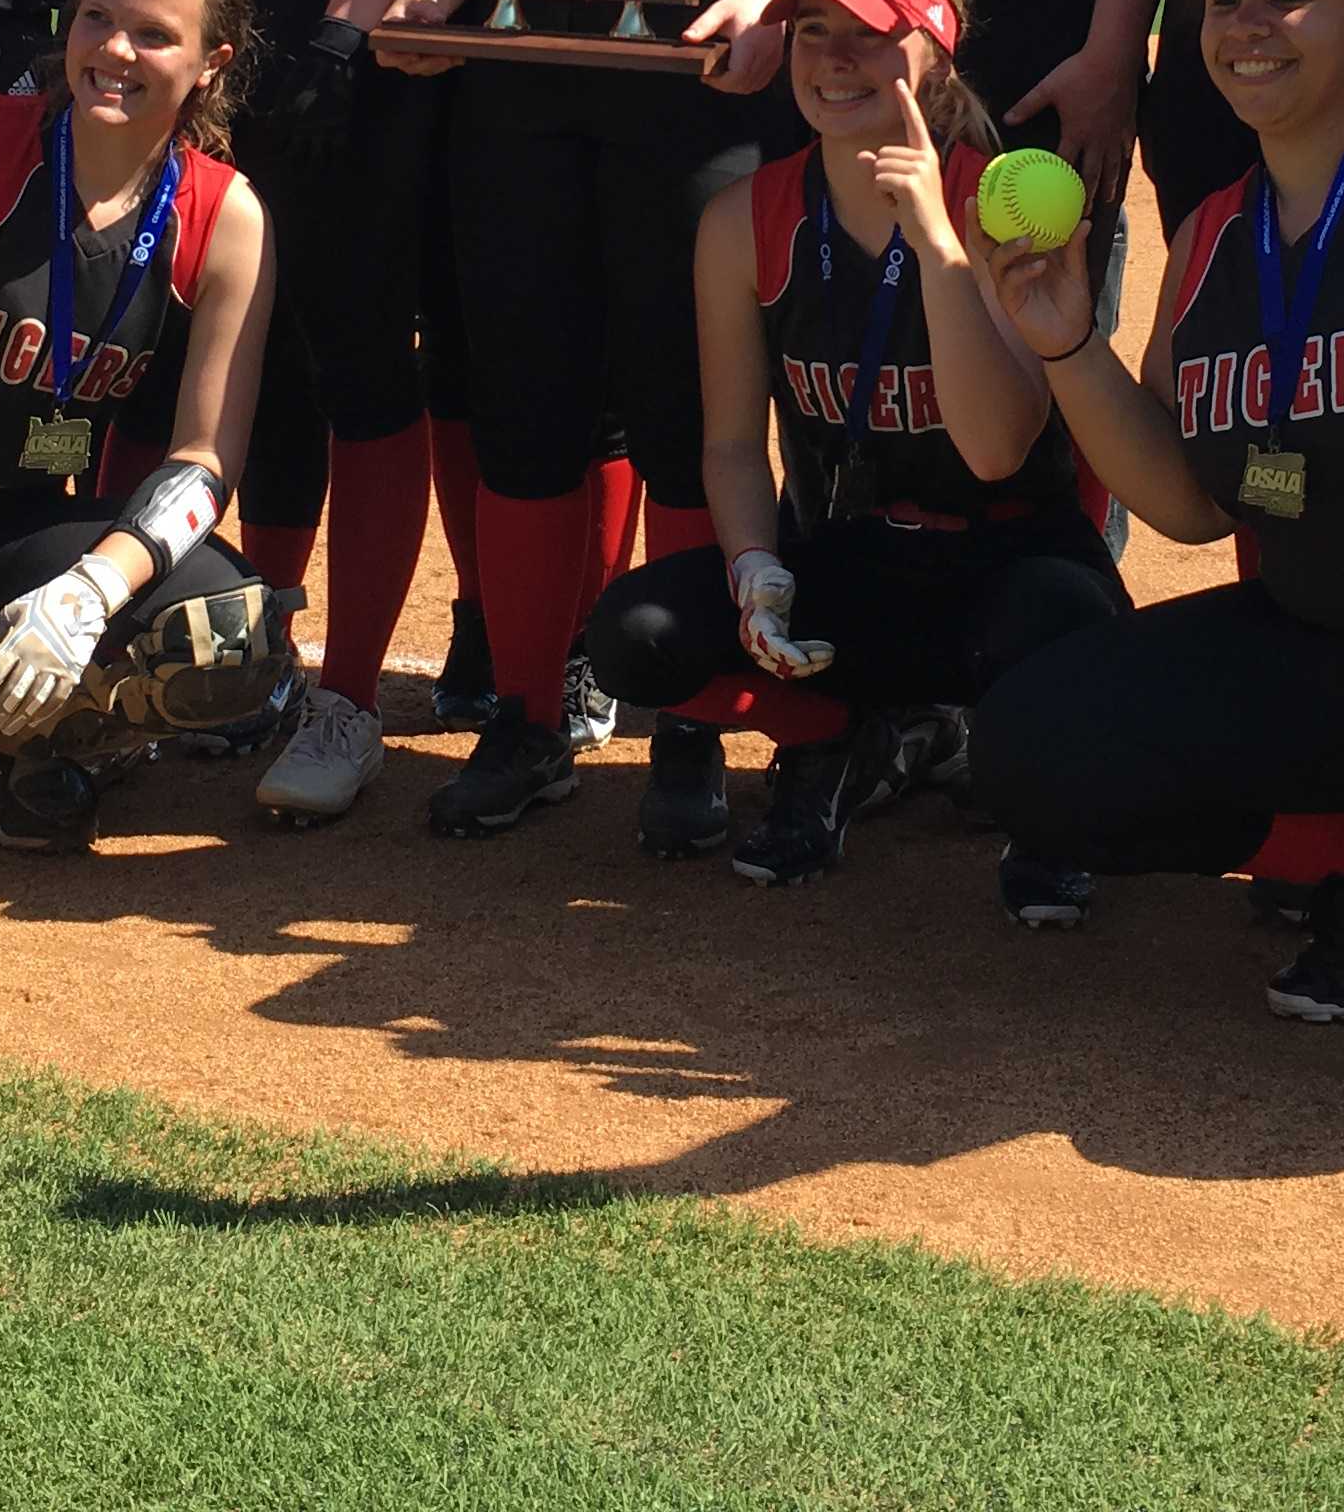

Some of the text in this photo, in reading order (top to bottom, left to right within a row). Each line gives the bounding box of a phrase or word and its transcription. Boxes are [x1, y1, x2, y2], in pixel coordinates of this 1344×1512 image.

[128, 229, 157, 269] 100
[882, 248, 905, 287] 100
[30, 435, 88, 454] OSAA
[1246, 466, 1302, 494] OSAA
